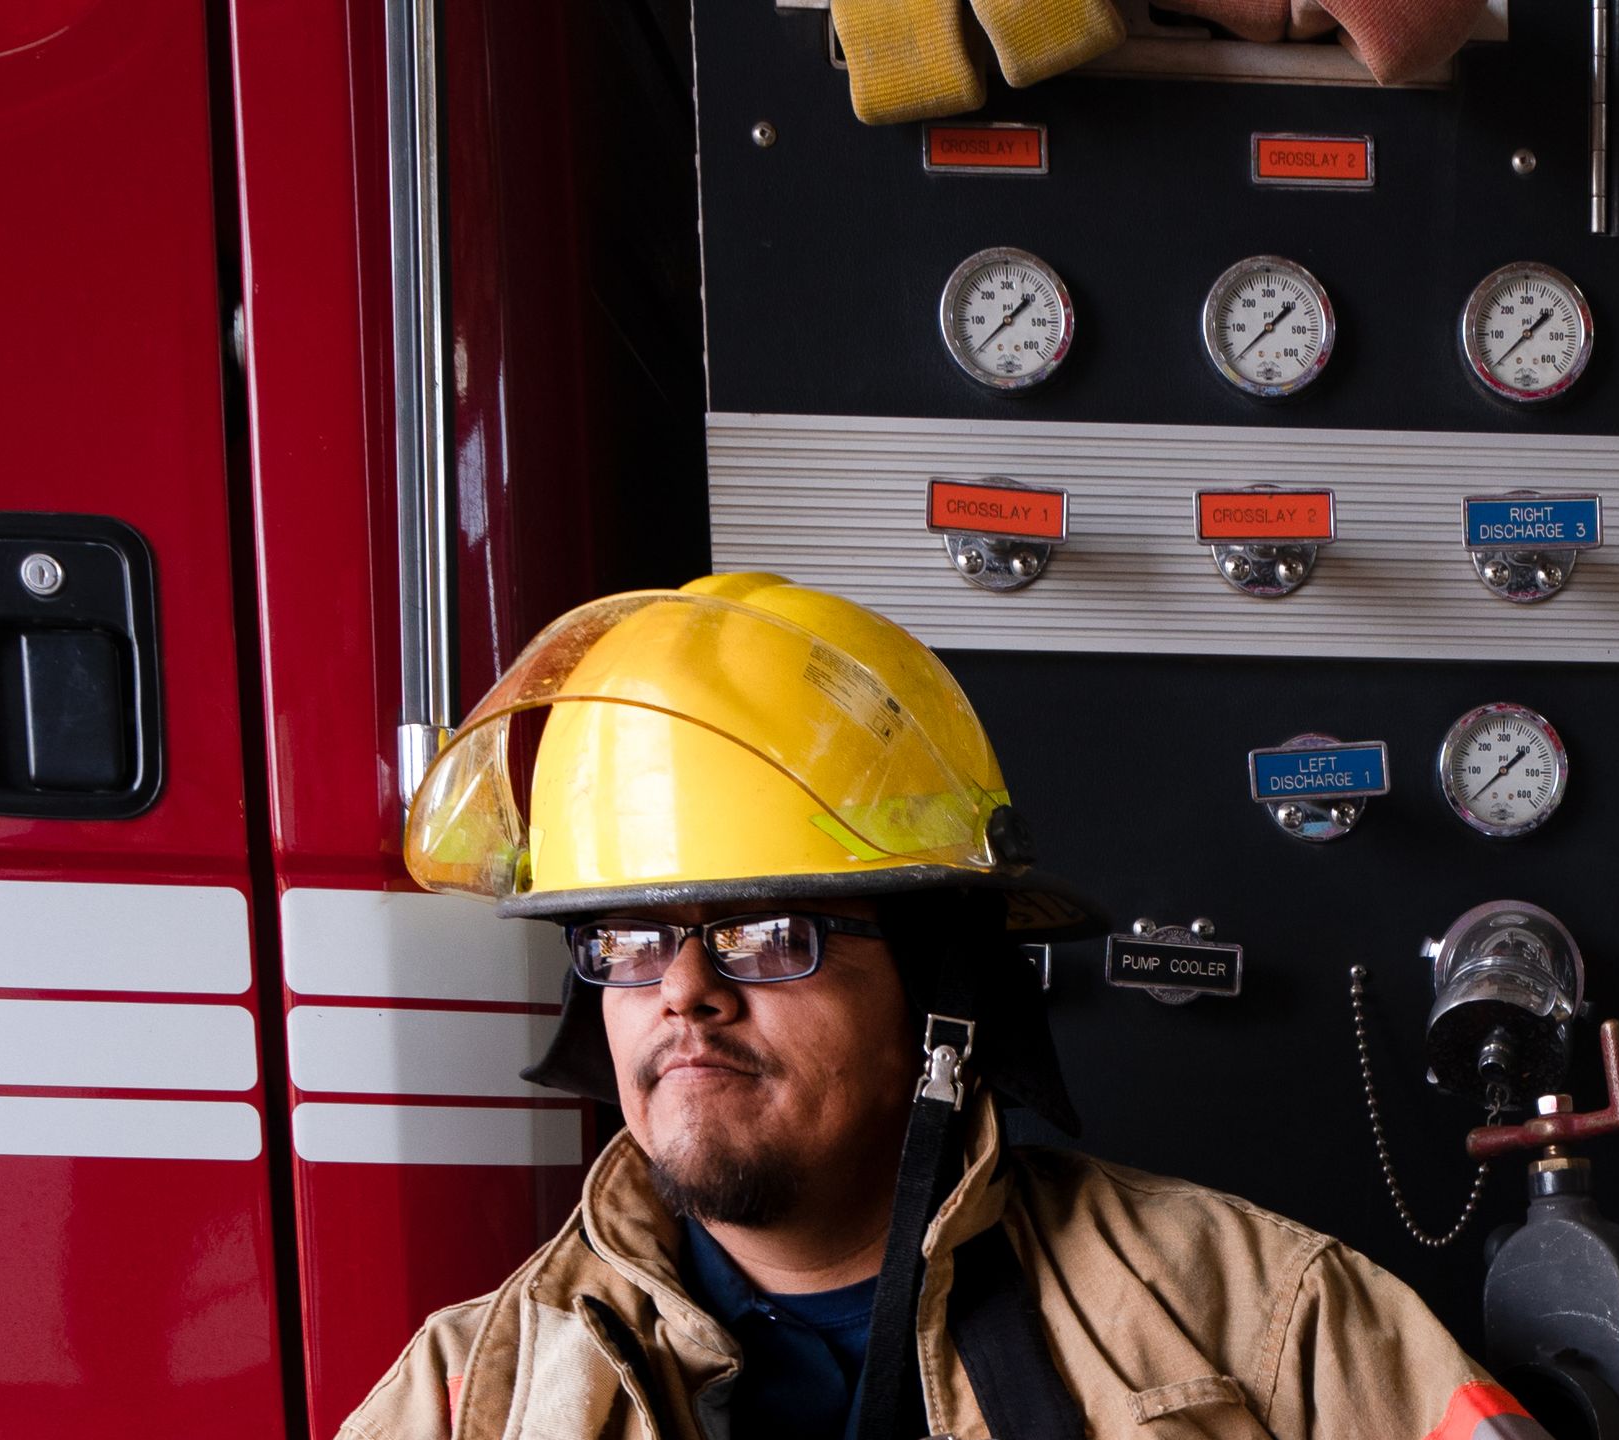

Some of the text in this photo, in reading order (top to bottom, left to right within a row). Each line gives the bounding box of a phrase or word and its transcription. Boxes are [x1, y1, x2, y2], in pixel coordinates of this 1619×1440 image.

[940, 139, 1014, 155] CROSSLAY
[1269, 151, 1356, 168] CROSSLAY 2
[981, 292, 995, 300] 200
[1520, 296, 1533, 304] 300
[1003, 303, 1013, 311] psi
[1242, 299, 1256, 307] 200
[1501, 306, 1514, 314] 200
[1264, 311, 1273, 319] psi
[971, 316, 985, 324] 100
[1032, 319, 1046, 327] 500
[1522, 318, 1532, 326] psi
[1232, 324, 1245, 332] 100
[1292, 326, 1306, 334] 500
[1024, 341, 1038, 349] 600
[1284, 349, 1298, 357] 600
[1541, 355, 1555, 363] 600
[946, 499, 1048, 522] CROSSLAY 1
[1509, 507, 1553, 522] RIGHT
[1212, 508, 1317, 523] CROSSLAY 2
[1479, 523, 1586, 539] DISCHARGE 3
[1497, 734, 1510, 742] 300
[1478, 743, 1491, 751] 200
[1299, 757, 1337, 773] LEFT
[1468, 766, 1481, 774] 100
[1526, 769, 1539, 777] 500
[1270, 771, 1370, 790] DISCHARGE 1
[1122, 954, 1226, 976] PUMP COOLER
